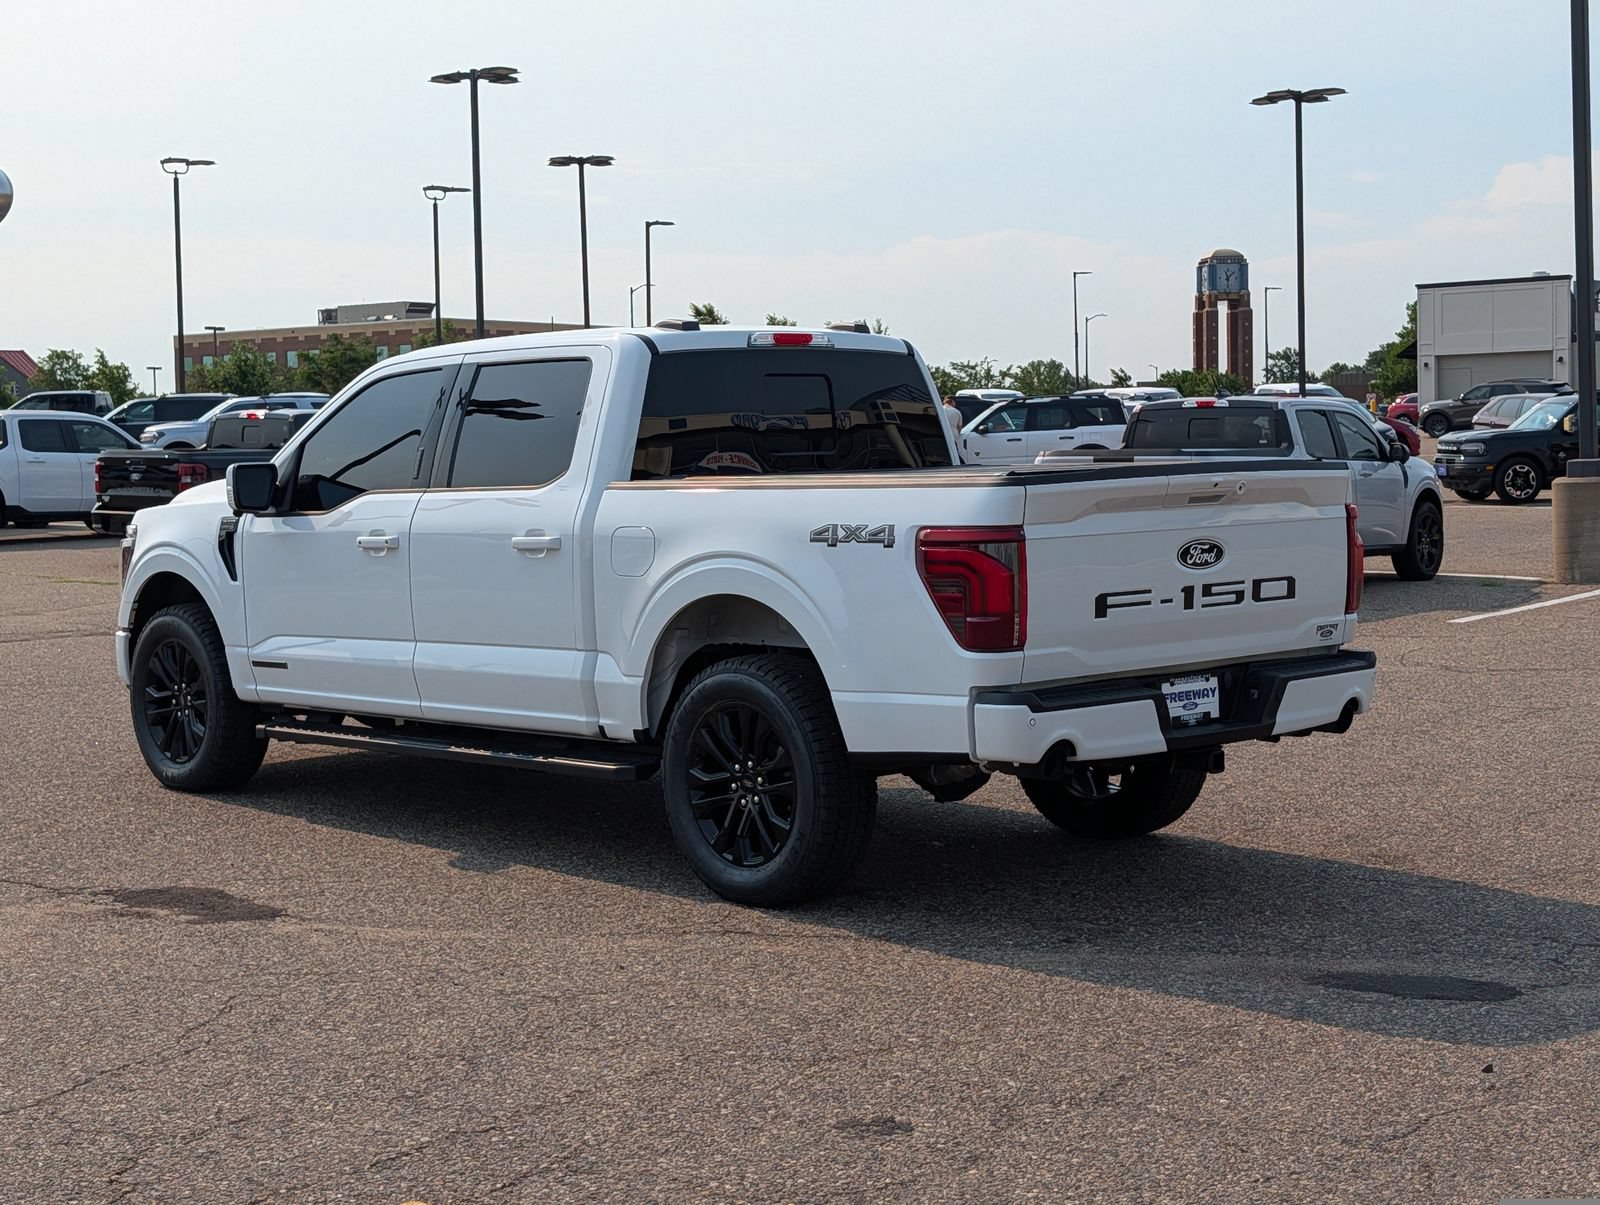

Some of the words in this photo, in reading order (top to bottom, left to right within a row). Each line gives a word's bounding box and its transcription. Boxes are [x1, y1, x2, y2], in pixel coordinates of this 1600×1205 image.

[1186, 544, 1217, 564] Ford
[1094, 576, 1296, 619] F-150
[1163, 687, 1217, 703] FREEWAY
